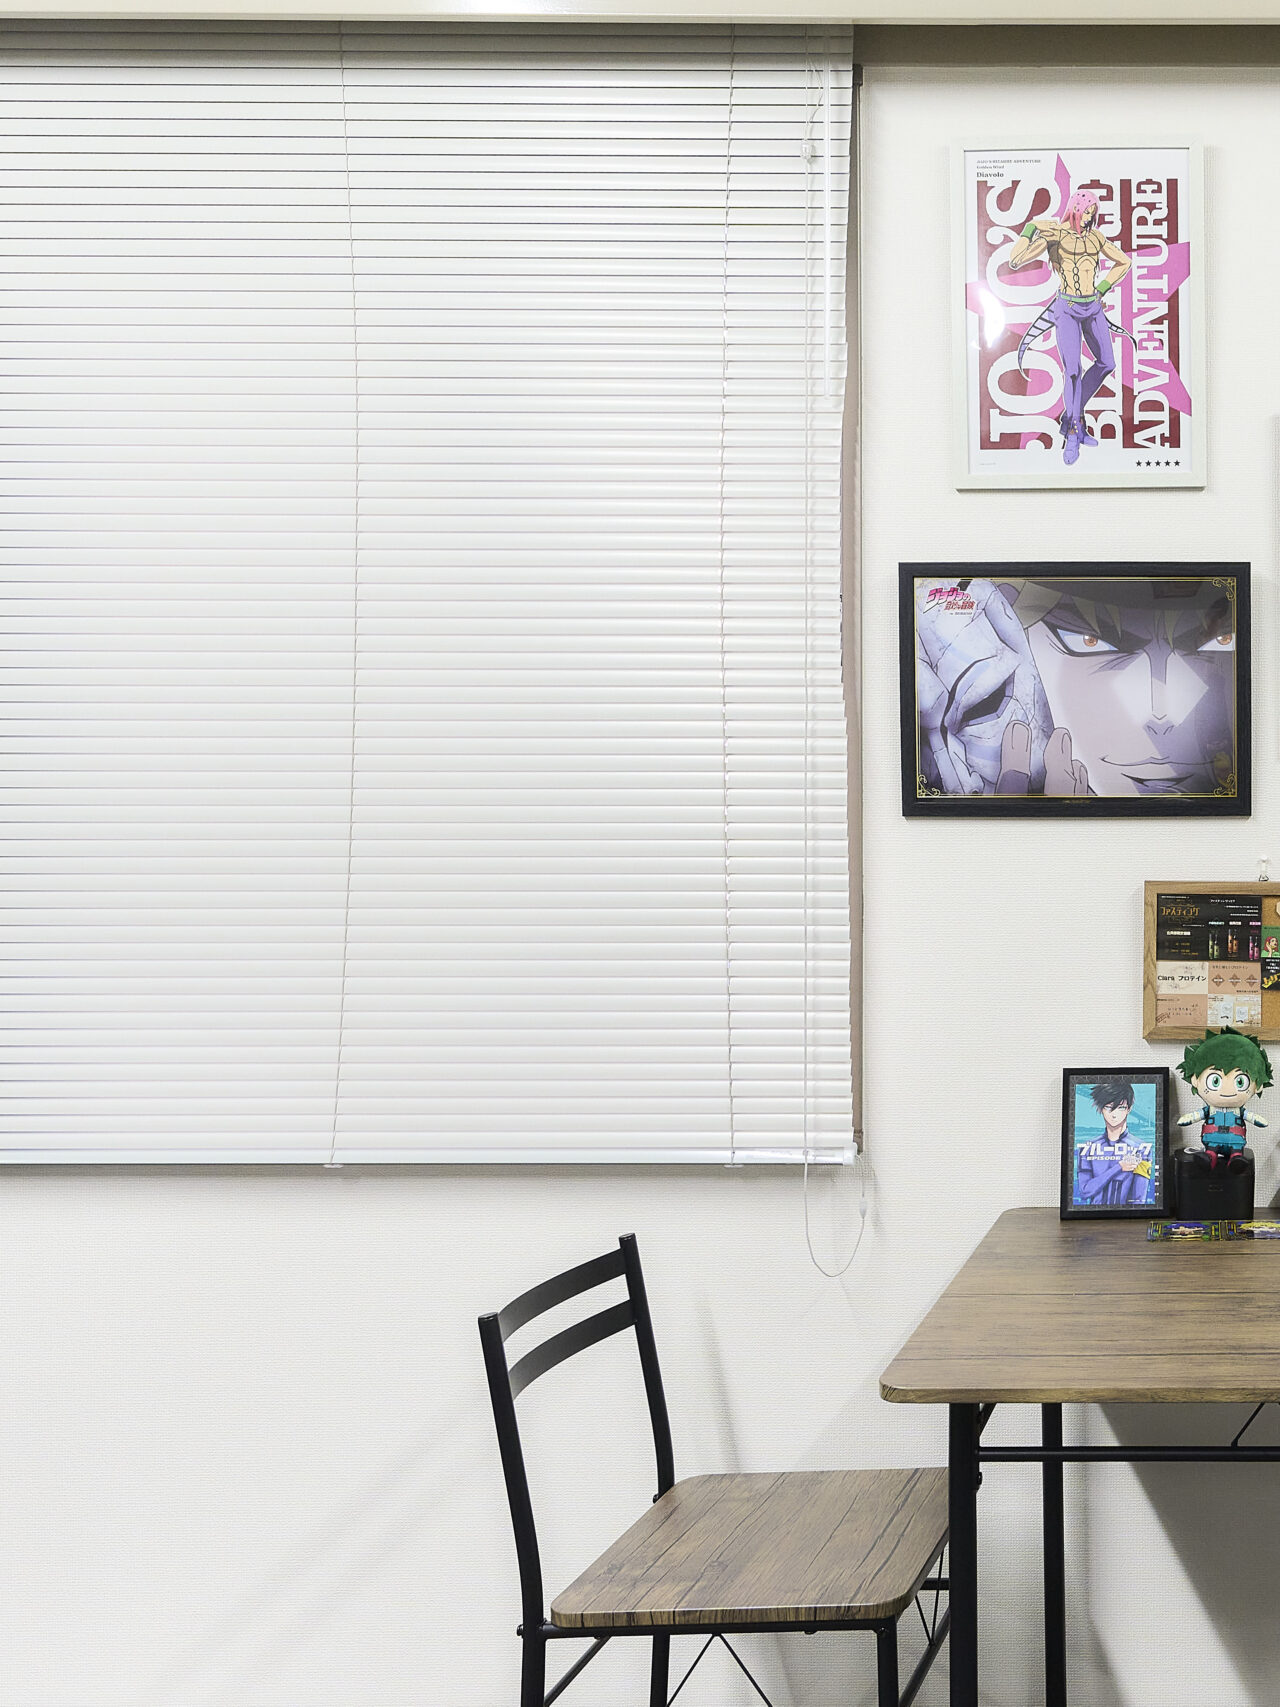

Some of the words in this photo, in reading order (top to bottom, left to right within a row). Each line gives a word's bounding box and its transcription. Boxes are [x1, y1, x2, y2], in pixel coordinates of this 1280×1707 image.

[1131, 179, 1170, 449] ADVENTURE
[1076, 1141, 1153, 1156] ブルーロック
